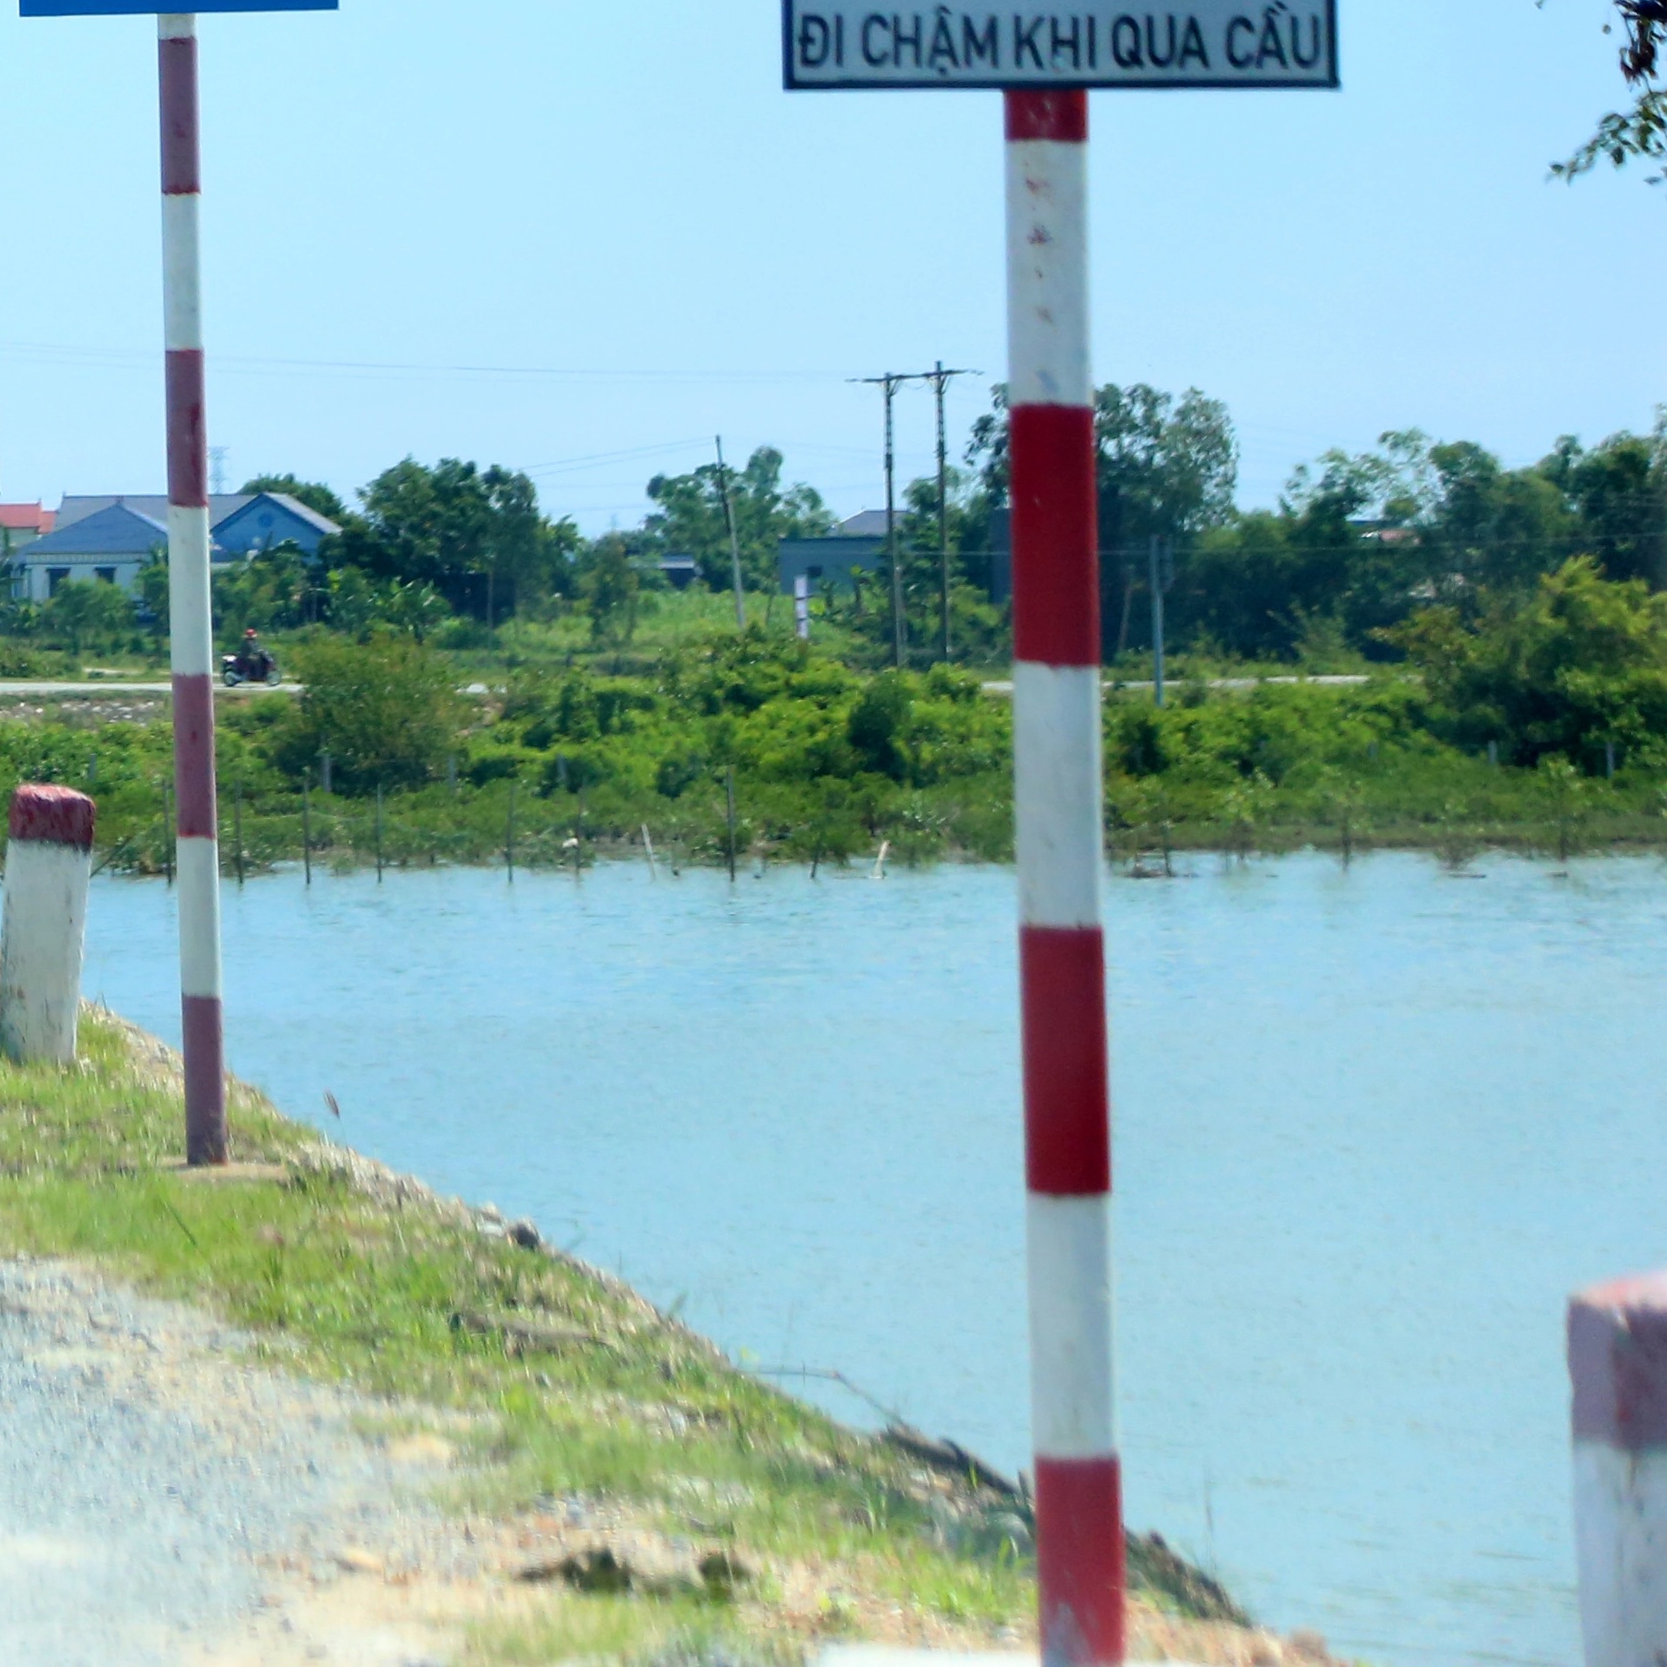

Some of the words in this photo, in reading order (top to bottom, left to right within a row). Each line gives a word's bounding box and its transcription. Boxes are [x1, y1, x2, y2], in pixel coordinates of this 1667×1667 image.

[798, 13, 844, 68] ĐI
[860, 3, 1001, 76] CHẬM
[1013, 15, 1097, 70] KHI
[1111, 13, 1210, 69] QUA
[1224, 0, 1322, 69] CẦU
